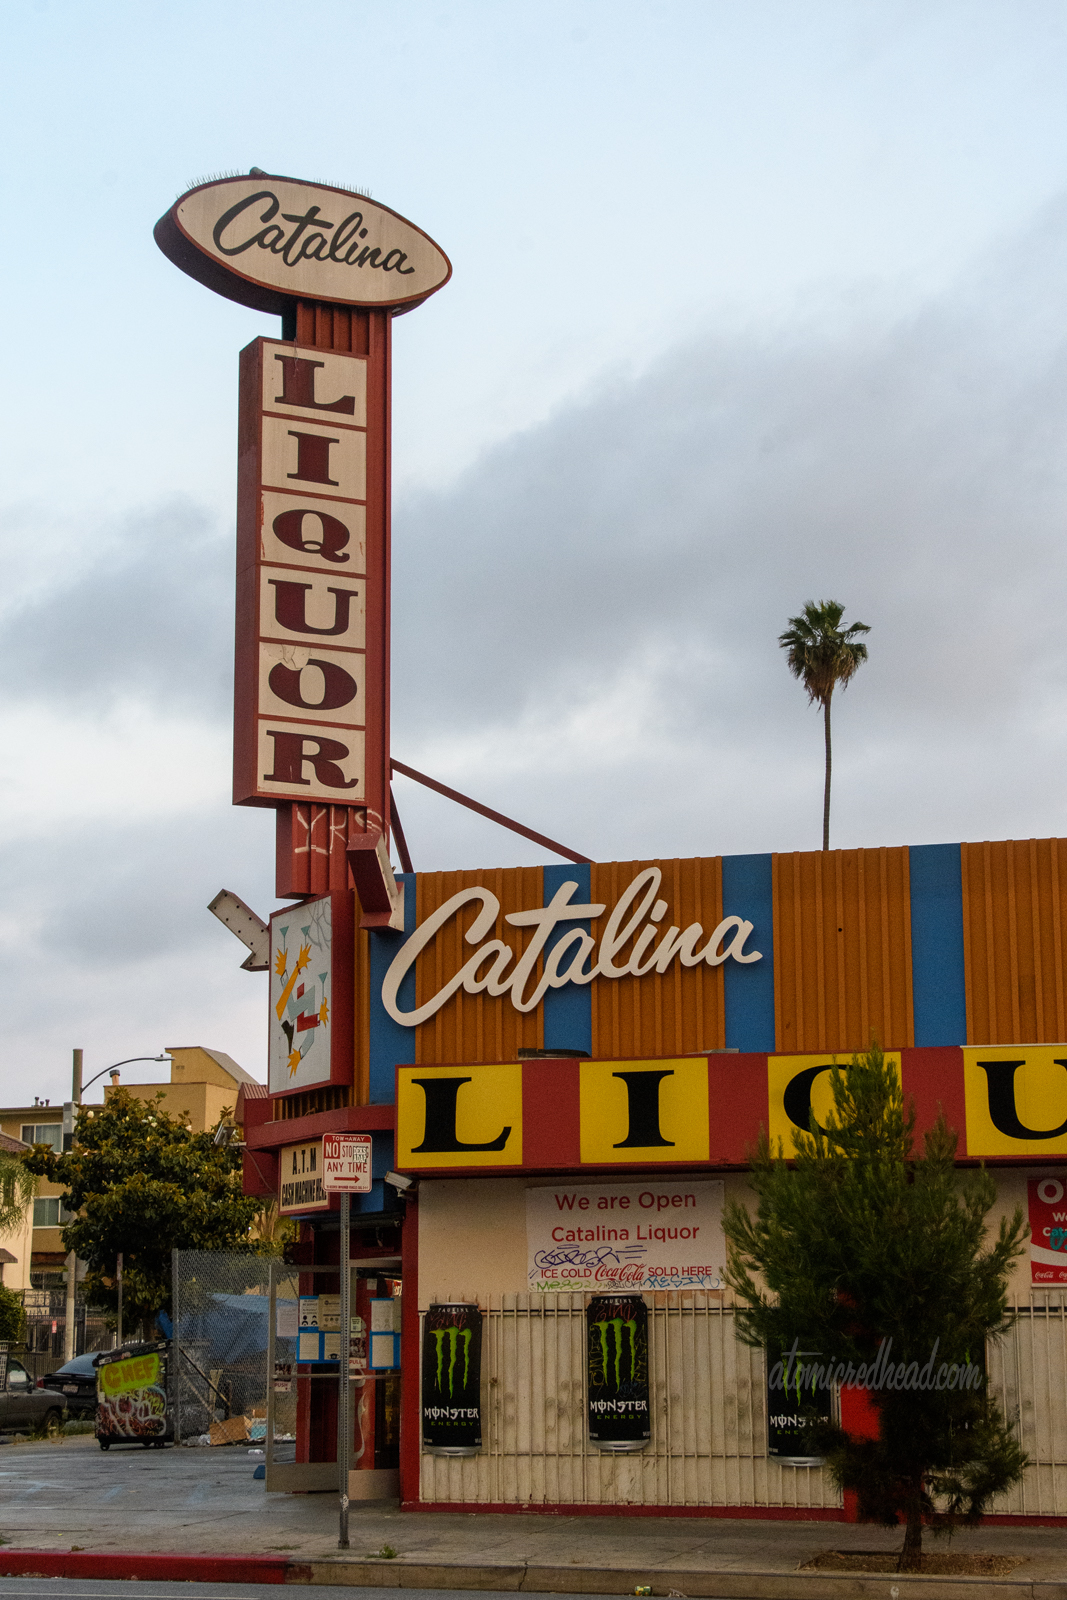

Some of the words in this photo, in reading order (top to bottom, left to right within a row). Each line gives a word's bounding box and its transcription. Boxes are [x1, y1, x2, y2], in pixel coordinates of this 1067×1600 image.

[212, 190, 415, 275] Catalina
[263, 353, 360, 789] LIQUOR
[381, 867, 763, 1028] Catalina
[325, 1142, 339, 1157] NO
[327, 1162, 344, 1173] ANY
[348, 1162, 368, 1174] TIME
[555, 1194, 590, 1210] We
[597, 1195, 631, 1210] are
[638, 1192, 697, 1212] Open
[551, 1225, 630, 1242] Catalina
[636, 1224, 700, 1243] Liquor
[541, 1268, 559, 1279] ICE
[561, 1267, 592, 1279] COLD
[648, 1265, 679, 1278] SOLD
[681, 1265, 713, 1277] HERE
[424, 1405, 480, 1420] MONSTER
[589, 1398, 648, 1414] MONSTER
